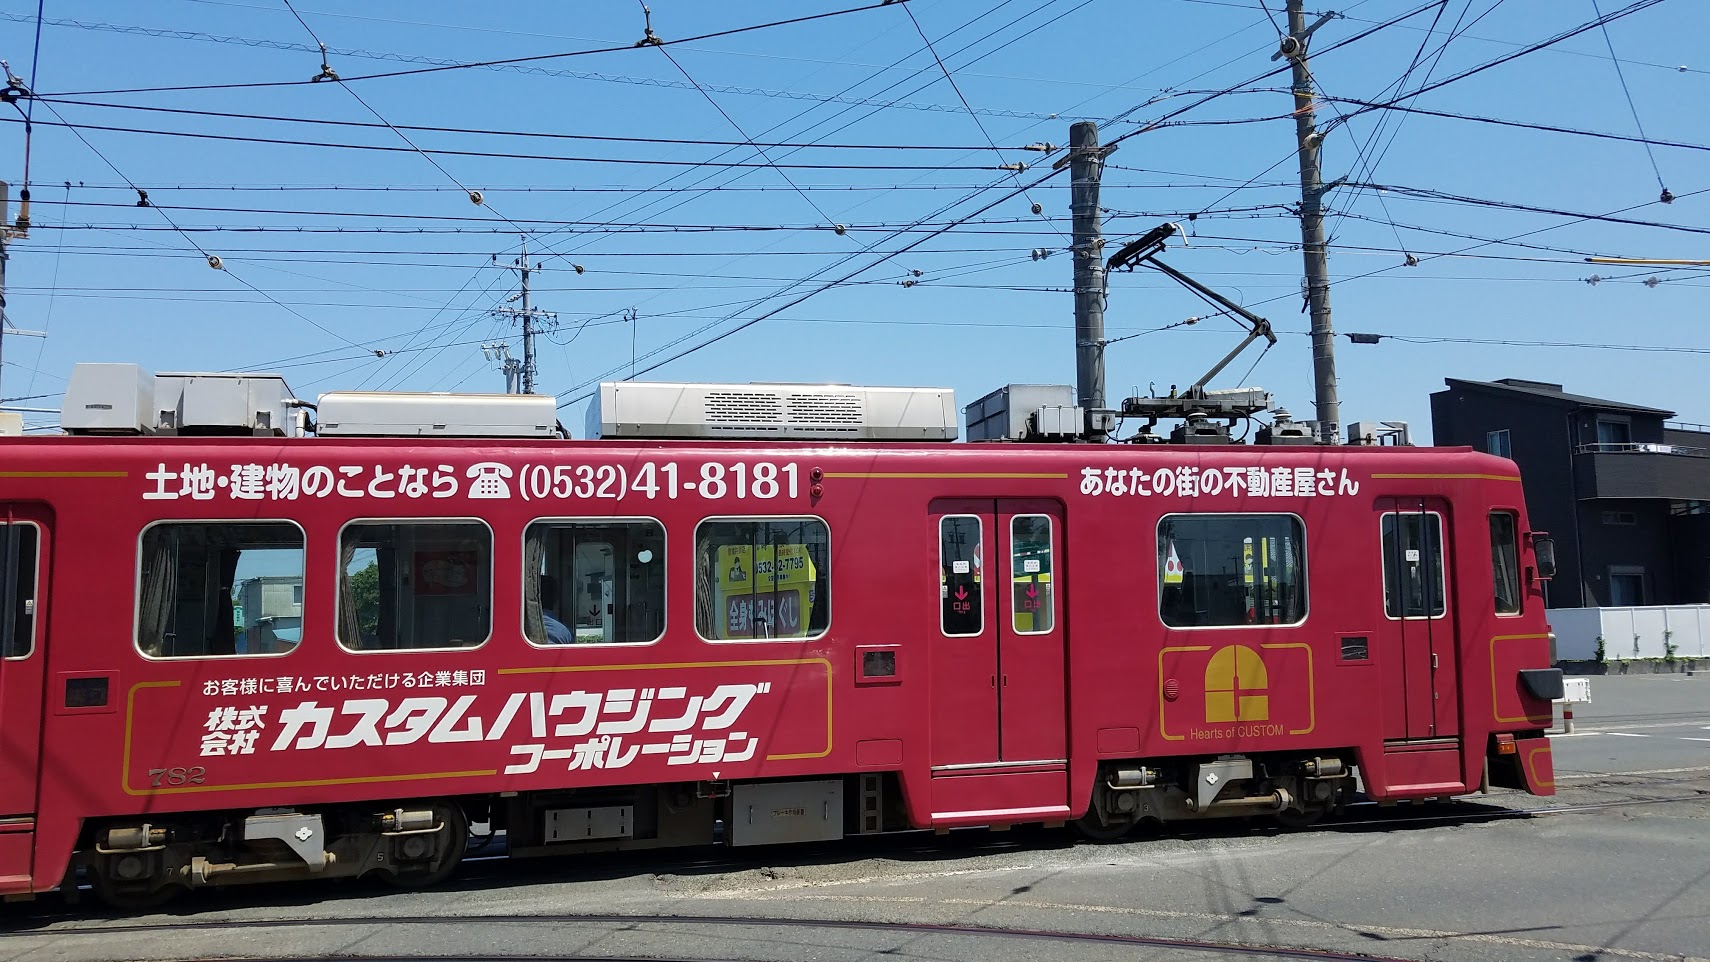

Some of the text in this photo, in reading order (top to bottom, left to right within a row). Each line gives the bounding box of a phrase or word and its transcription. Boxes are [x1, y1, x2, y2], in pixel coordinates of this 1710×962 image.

[142, 463, 458, 500] 土地・建物のことなら
[519, 462, 799, 501] (0532)41-8181
[1079, 466, 1360, 498] あなたの街の不動産屋さん
[755, 556, 804, 575] 532-2-7795
[202, 669, 486, 695] お客様に喜んでいただける企業集団
[203, 704, 268, 731] 株式
[270, 682, 772, 751] カスタムハウジング
[199, 730, 261, 757] 会社
[1190, 724, 1284, 740] Hearts of CUSTOM
[503, 731, 759, 775] コーポレーション
[148, 766, 206, 787] 782
[377, 852, 384, 862] 5
[166, 867, 174, 877] 7
